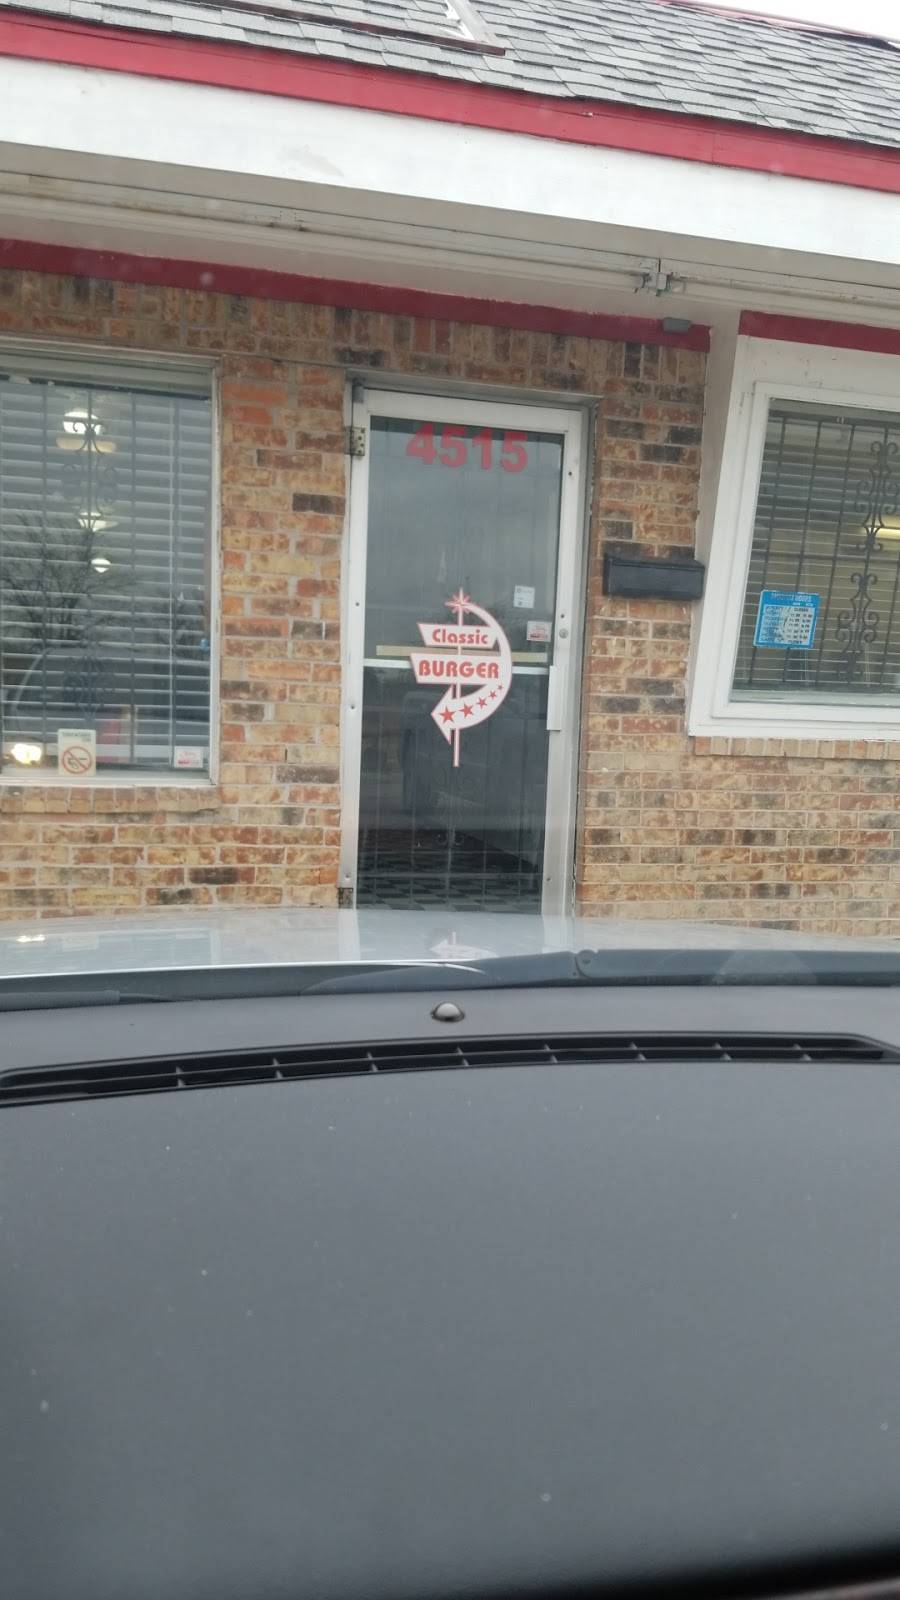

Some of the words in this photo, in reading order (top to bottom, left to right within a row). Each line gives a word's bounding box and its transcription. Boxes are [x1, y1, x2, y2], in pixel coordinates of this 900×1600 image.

[406, 422, 528, 473] 4515
[432, 628, 488, 644] Classic
[419, 660, 499, 679] BURGER
